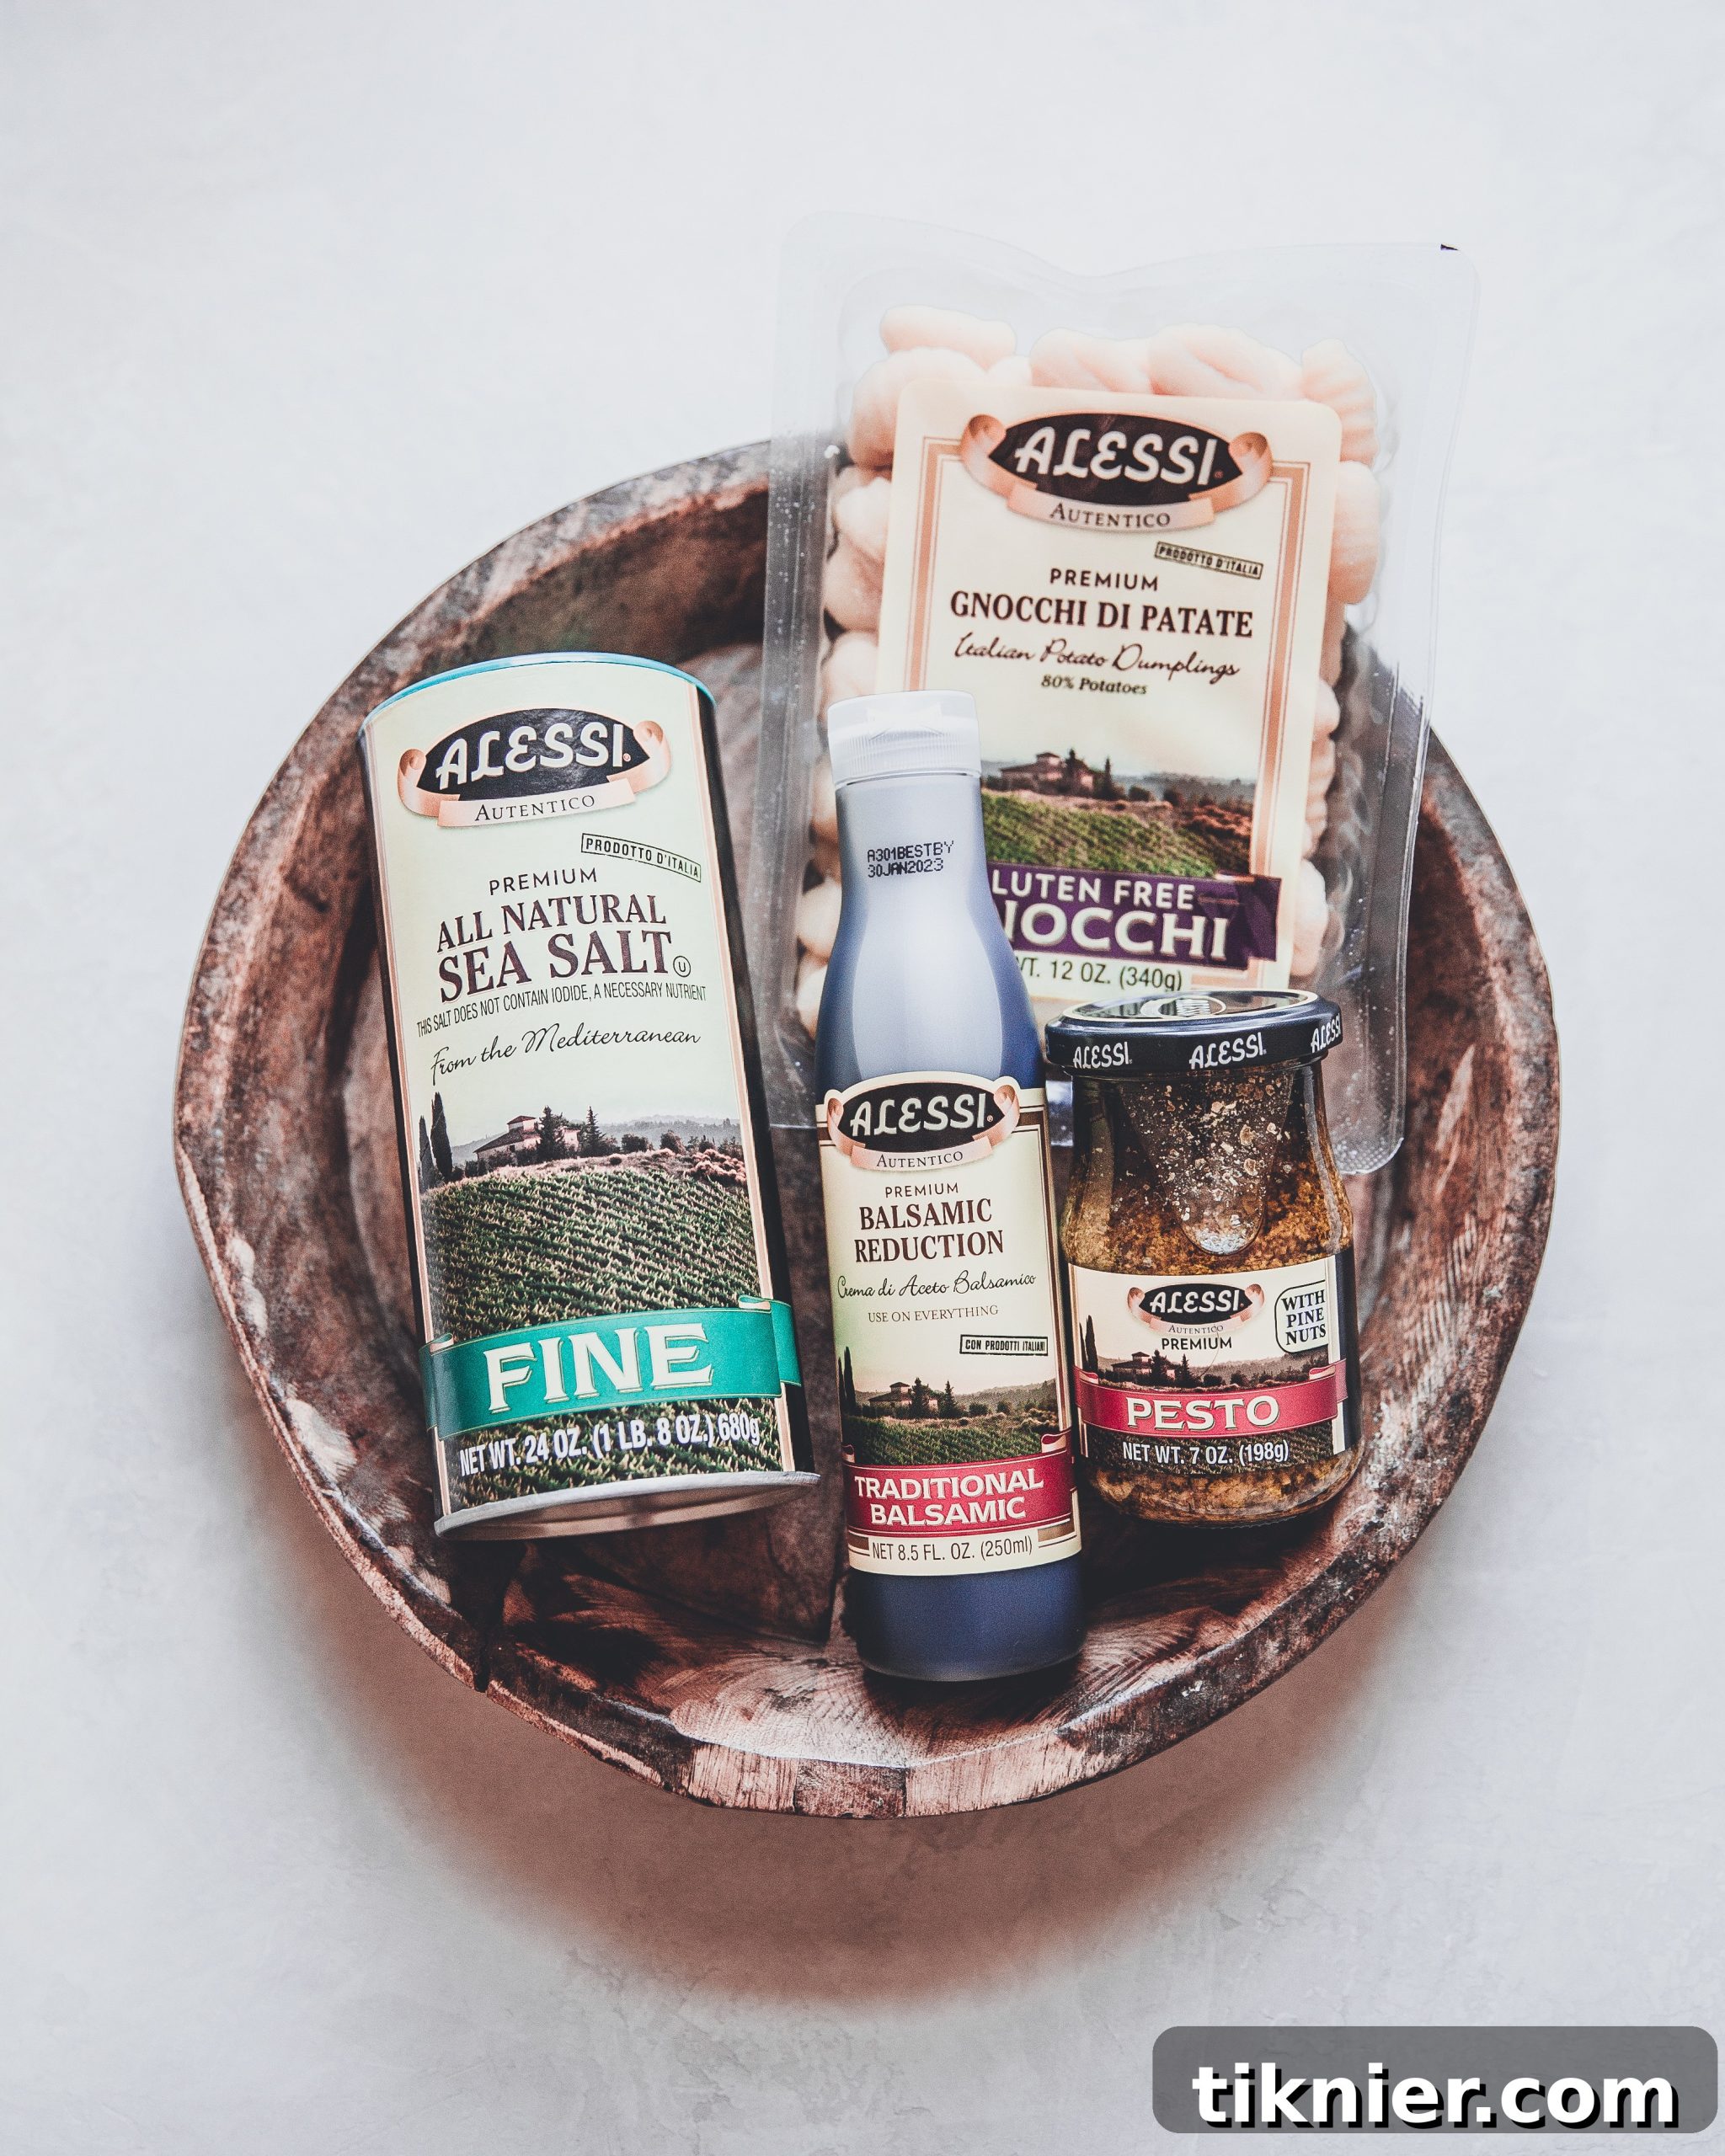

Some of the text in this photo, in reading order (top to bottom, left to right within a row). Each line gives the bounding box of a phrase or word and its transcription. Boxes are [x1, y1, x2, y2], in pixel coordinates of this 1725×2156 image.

[1014, 426, 1219, 487] ALESSI
[1049, 502, 1172, 529] AUTENTICO
[1159, 546, 1259, 577] PRODOTTO D'ITALIA
[1049, 568, 1159, 592] PREMIUM
[950, 590, 1253, 638] GNOCCHI DI PATATE
[954, 631, 1241, 686] Italian Potato Dumplings
[1041, 674, 1149, 696] 80% Potatoes
[435, 722, 624, 789] ALESSI
[474, 795, 595, 822] AUTENTICO
[585, 838, 700, 878] PRODOTTO D'ITALIA
[868, 857, 943, 878] 30JAN2023
[489, 867, 598, 895] PREMIUM
[992, 869, 1197, 911] LUTEN FREE
[437, 894, 667, 953] ALL NATURAL
[1004, 899, 1228, 960] OCCHI
[439, 942, 532, 1003] SEA
[549, 931, 672, 980] SALT
[1051, 960, 1072, 980] 12
[1081, 962, 1111, 985] OZ.
[1119, 966, 1183, 992] (340g)
[417, 982, 707, 1038] THIS SALT DOES NOT CONTAIN IODIDE, A NECESSARY NUTRIENT
[1310, 1012, 1341, 1053] ALESSI
[430, 1022, 701, 1086] From the Mediterranean
[1073, 1042, 1130, 1069] ALESSI
[1188, 1032, 1264, 1070] ALESSI
[850, 1093, 986, 1136] ALESSI
[876, 1150, 964, 1168] AUTENTICO
[885, 1182, 959, 1198] PREMIUM
[859, 1198, 992, 1230] BALSAMIC
[854, 1230, 1004, 1262] REDUCTION
[837, 1270, 1037, 1299] Crema di Aceto Balsamico
[1281, 1289, 1326, 1311] WITH
[868, 1305, 999, 1323] USE ON EVERYTHING
[1149, 1289, 1241, 1315] ALESSI
[1168, 1323, 1224, 1335] AUTENTICO
[1286, 1308, 1325, 1328] PINE
[965, 1339, 1045, 1352] CON PRODOTTI ITALIANI
[1162, 1337, 1232, 1350] PREMIUM
[1285, 1325, 1327, 1346] NUTS
[483, 1322, 714, 1415] FINE
[1126, 1396, 1280, 1430] PESTO
[460, 1412, 761, 1476] NET WT. 24 OZ. (1 LB. 8 OZ.) 680g
[1123, 1440, 1290, 1466] NET WT. 7 OZ. (198g)
[854, 1468, 1044, 1500] TRADITIONAL
[870, 1497, 1026, 1526] BALSAMIC
[872, 1535, 1033, 1561] NET 8.5 FL. OZ. (250ml)
